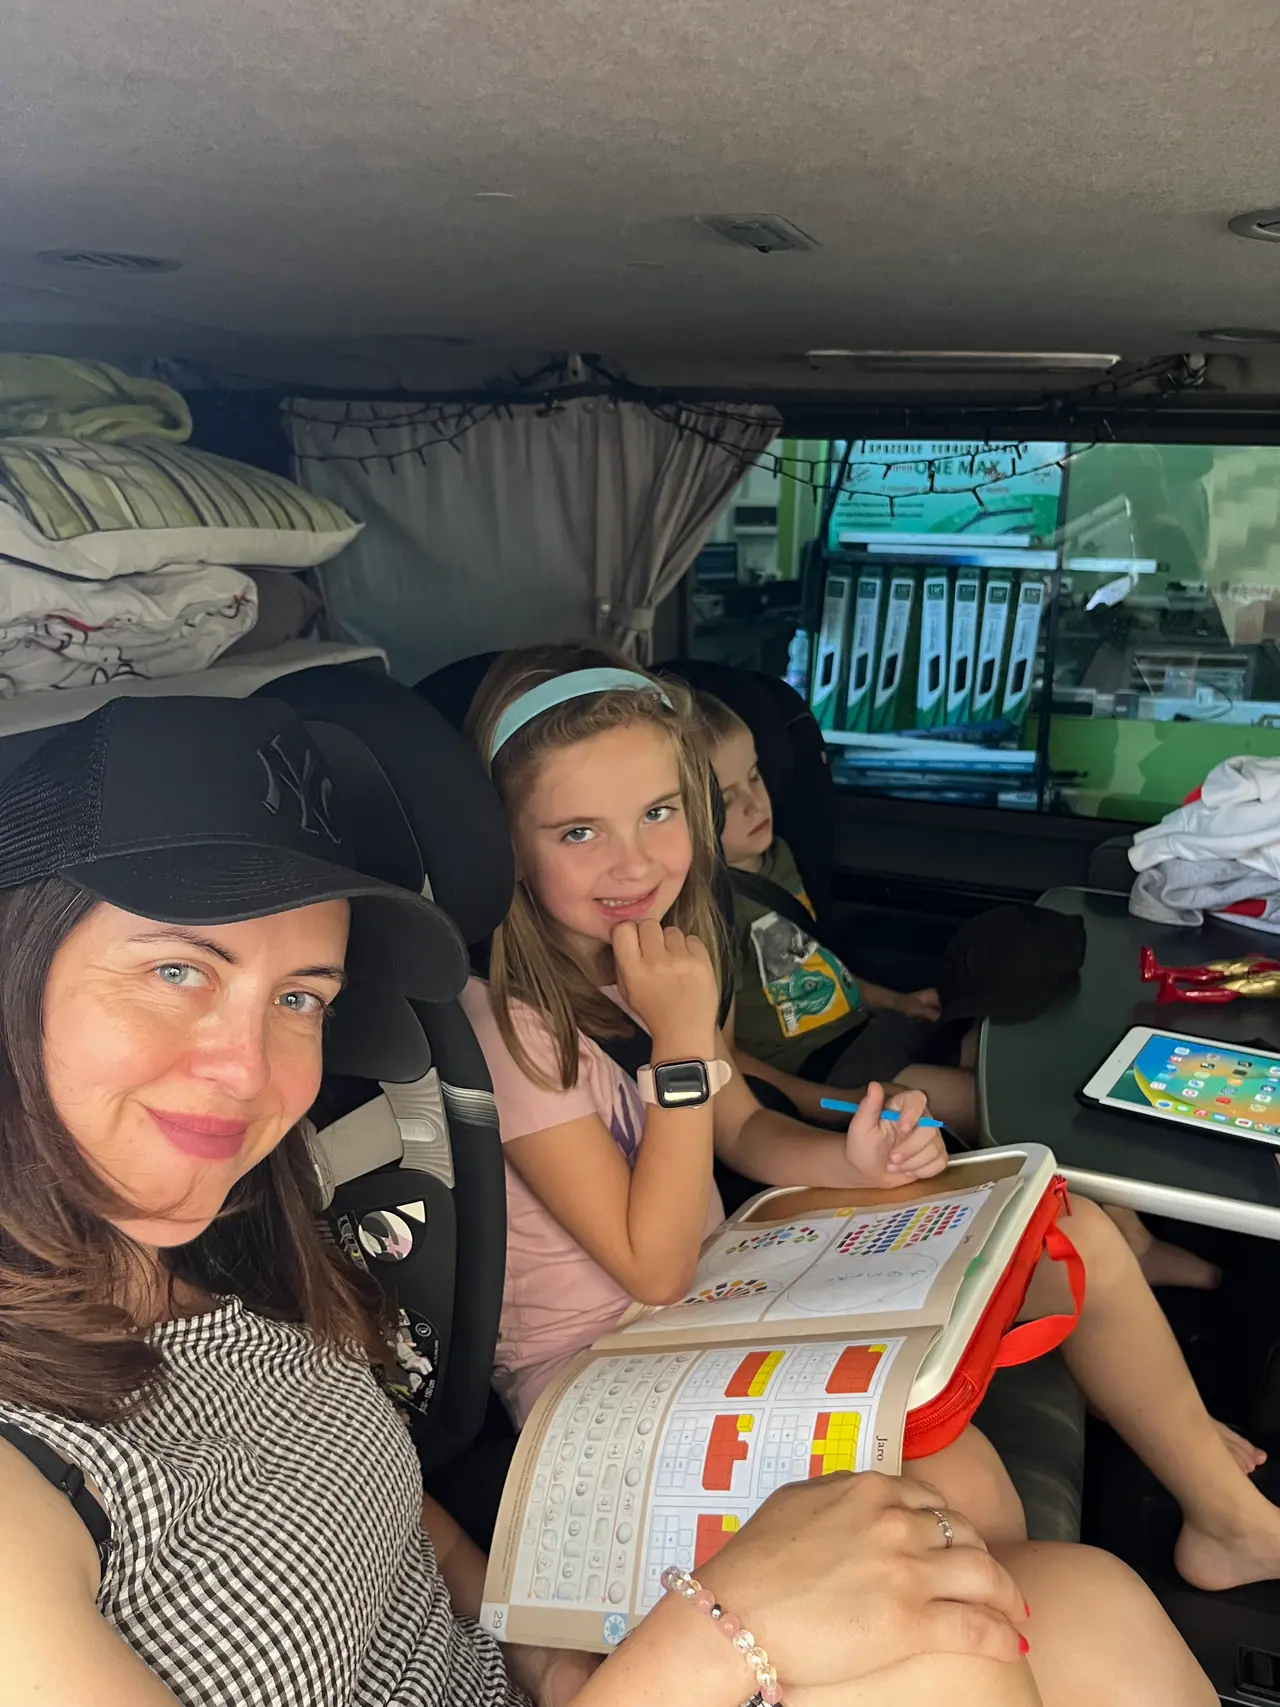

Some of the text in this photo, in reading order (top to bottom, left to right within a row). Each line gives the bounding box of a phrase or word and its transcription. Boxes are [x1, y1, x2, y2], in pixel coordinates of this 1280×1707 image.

[915, 460, 953, 475] ONE
[256, 733, 342, 844] NY
[876, 1435, 888, 1461] Jaro
[492, 1610, 503, 1628] 29
